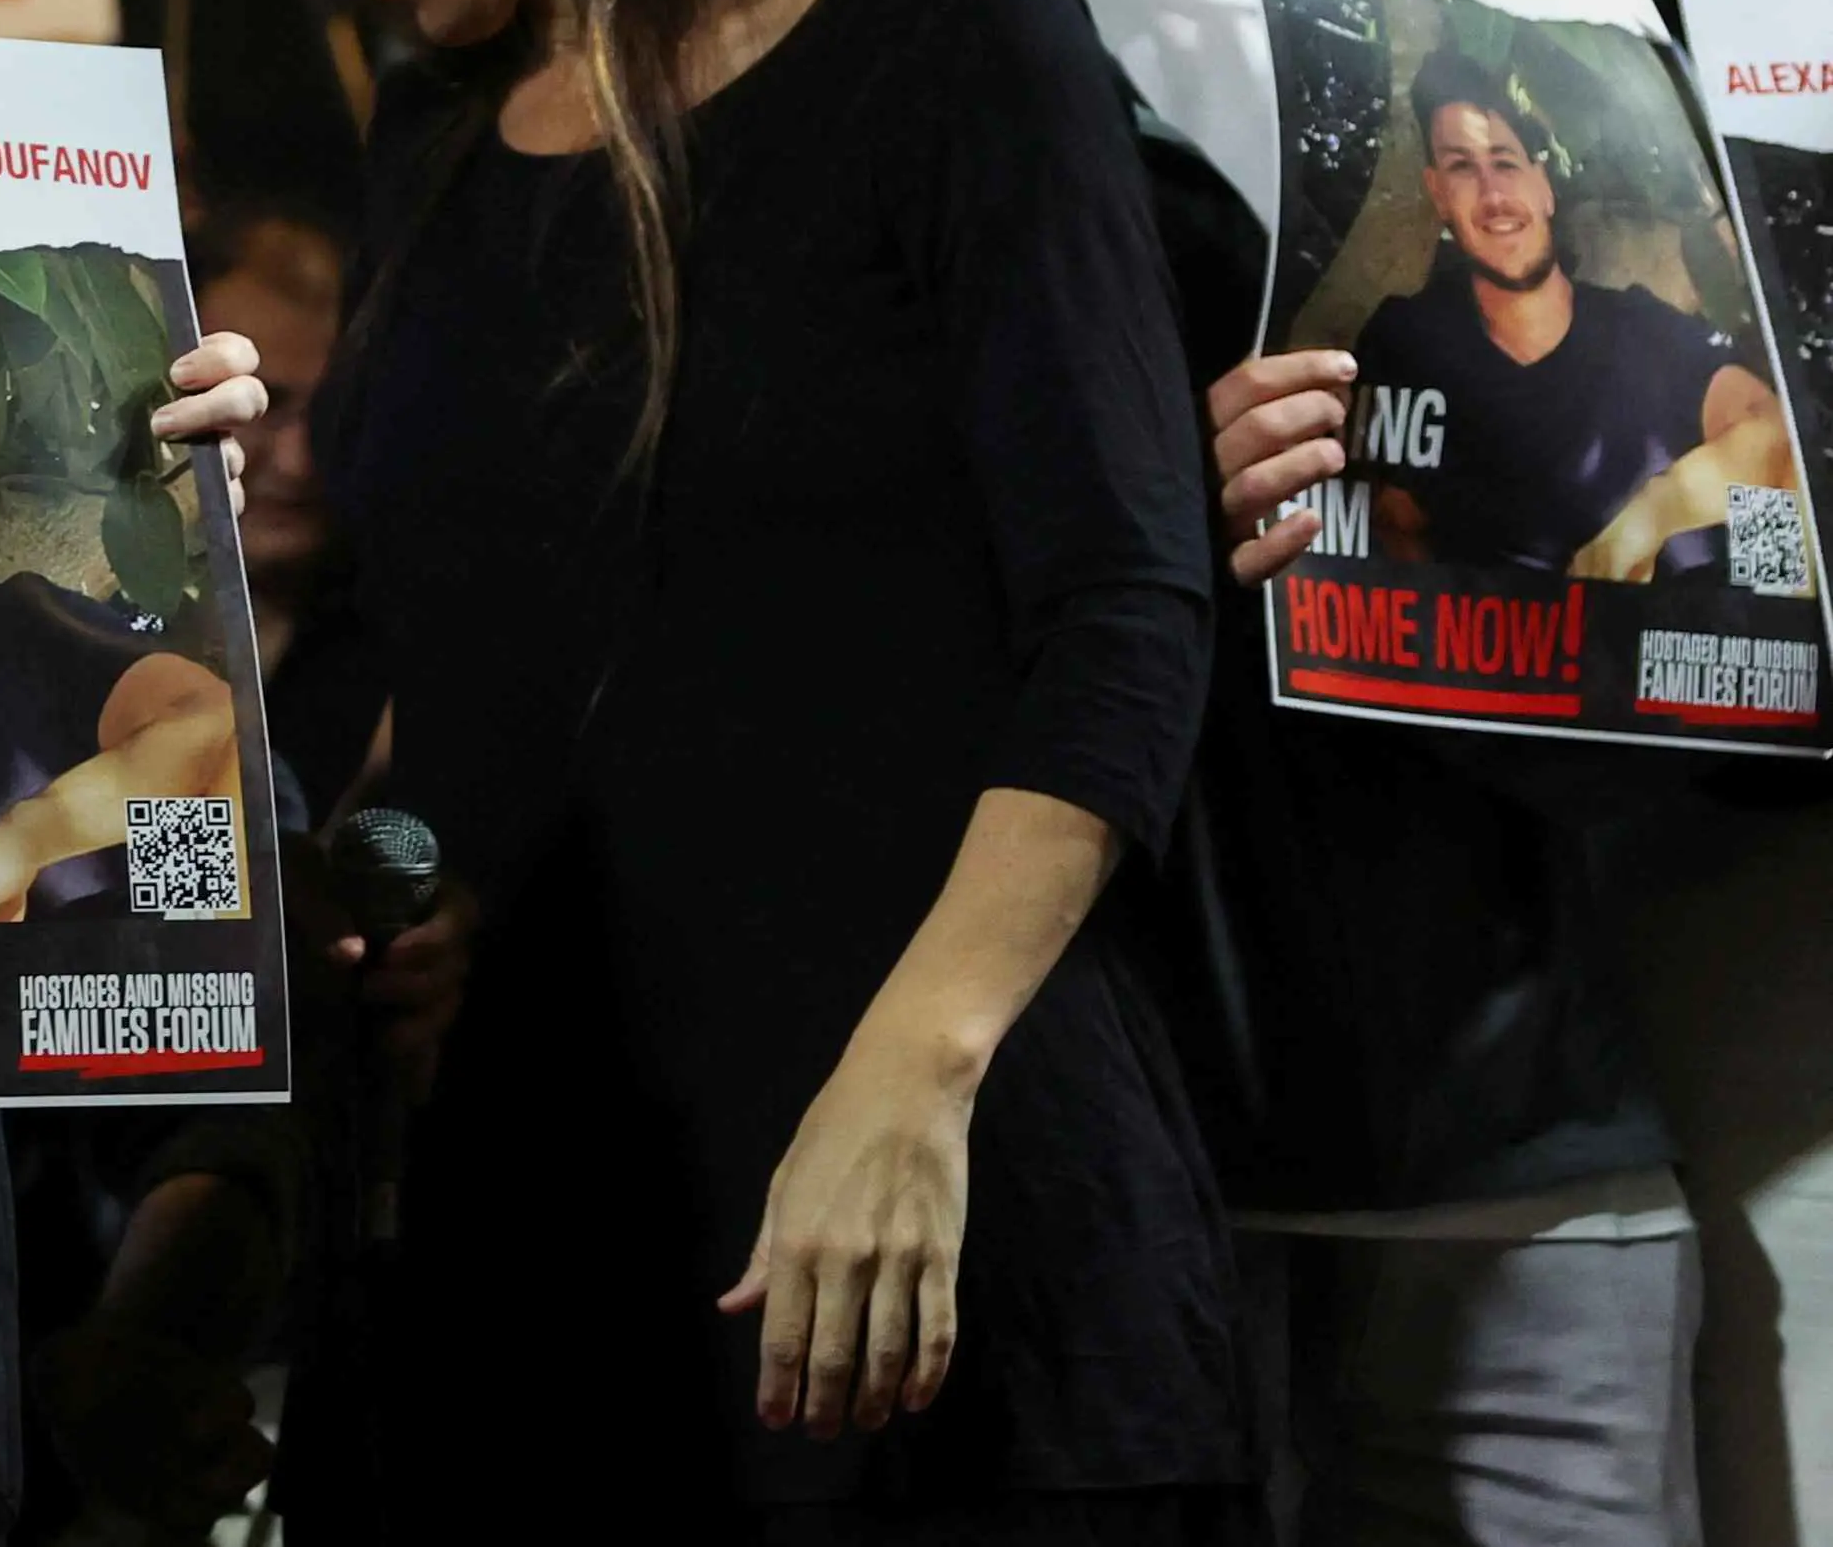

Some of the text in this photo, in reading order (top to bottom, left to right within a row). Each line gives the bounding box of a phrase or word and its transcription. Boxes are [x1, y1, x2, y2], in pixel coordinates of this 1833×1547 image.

[1350, 385, 1447, 468] ING
[1287, 576, 1585, 682] HOME NOW!
[1640, 630, 1819, 672] HOSTAGES AND MISSING
[1638, 659, 1818, 714] FAMILIES FORUM
[20, 972, 254, 1010] HOSTAGES AND MISSING
[21, 1005, 257, 1055] FAMILIES FORUM
